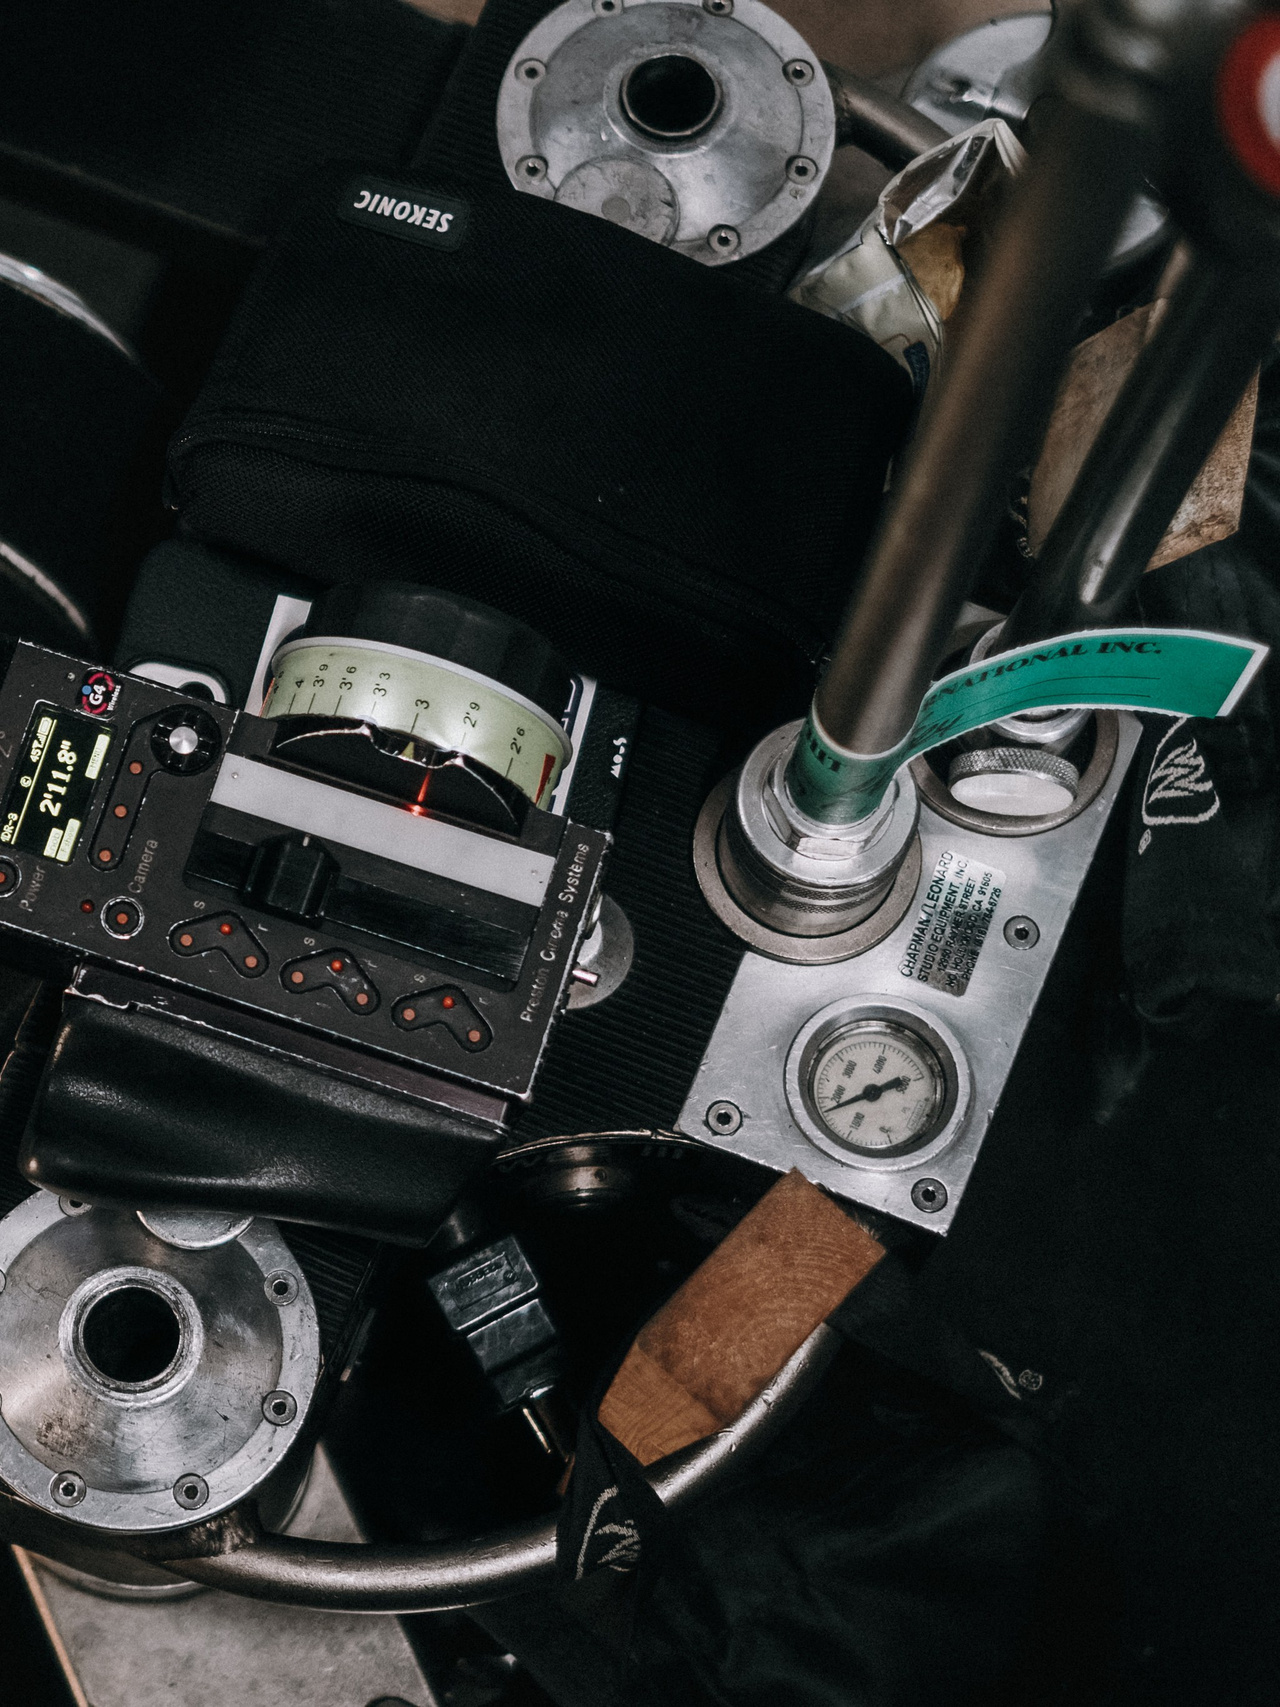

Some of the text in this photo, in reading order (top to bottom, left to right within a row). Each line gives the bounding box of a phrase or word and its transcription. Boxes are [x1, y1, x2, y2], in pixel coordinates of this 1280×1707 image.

[353, 190, 454, 233] SEKONIC
[1095, 641, 1162, 655] INC.
[89, 684, 106, 705] G4
[107, 685, 122, 711] Wireless
[415, 698, 430, 710] 3
[127, 839, 158, 894] Camera
[925, 851, 954, 910] LEONARD
[19, 865, 47, 912] Power
[972, 899, 983, 912] CA
[978, 872, 993, 896] 91605
[520, 842, 590, 1022] Preston Cinema Systems
[918, 860, 969, 982] STUDIO EQUIPMENT, INC.
[937, 877, 976, 972] 12950 RAYMER STREET
[962, 949, 980, 981] PHONE
[842, 1060, 857, 1078] 3000
[873, 1055, 887, 1074] 4000
[831, 1085, 846, 1104] 2000
[895, 1075, 911, 1094] 5000
[849, 1112, 865, 1130] 1000
